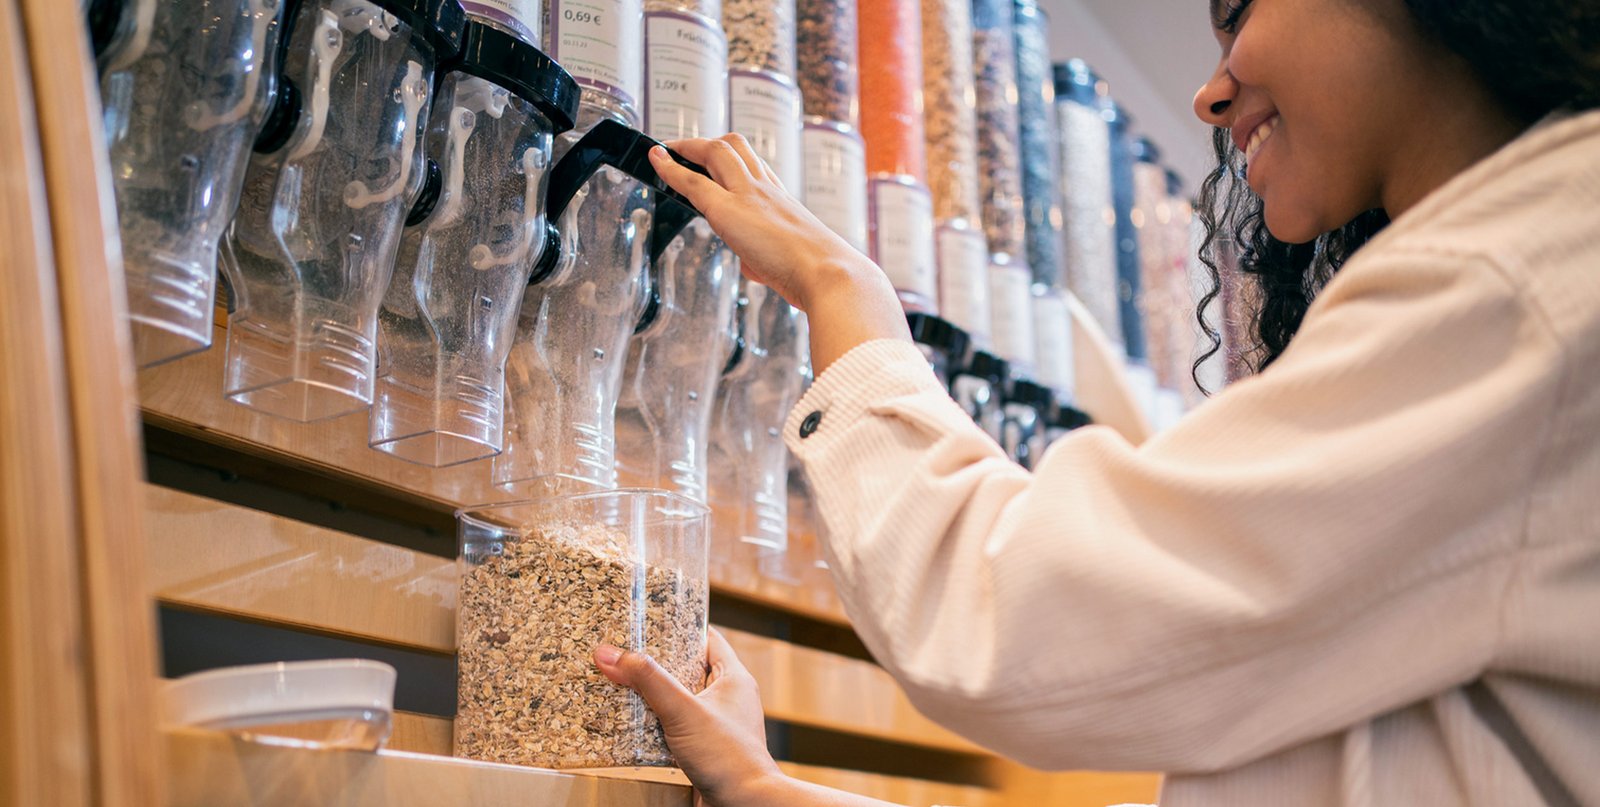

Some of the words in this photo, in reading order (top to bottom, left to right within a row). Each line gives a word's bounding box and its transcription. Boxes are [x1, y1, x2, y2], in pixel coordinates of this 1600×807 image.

[564, 9, 591, 23] 0,69
[593, 15, 602, 26] €
[655, 79, 679, 91] 1,09
[681, 82, 689, 94] €
